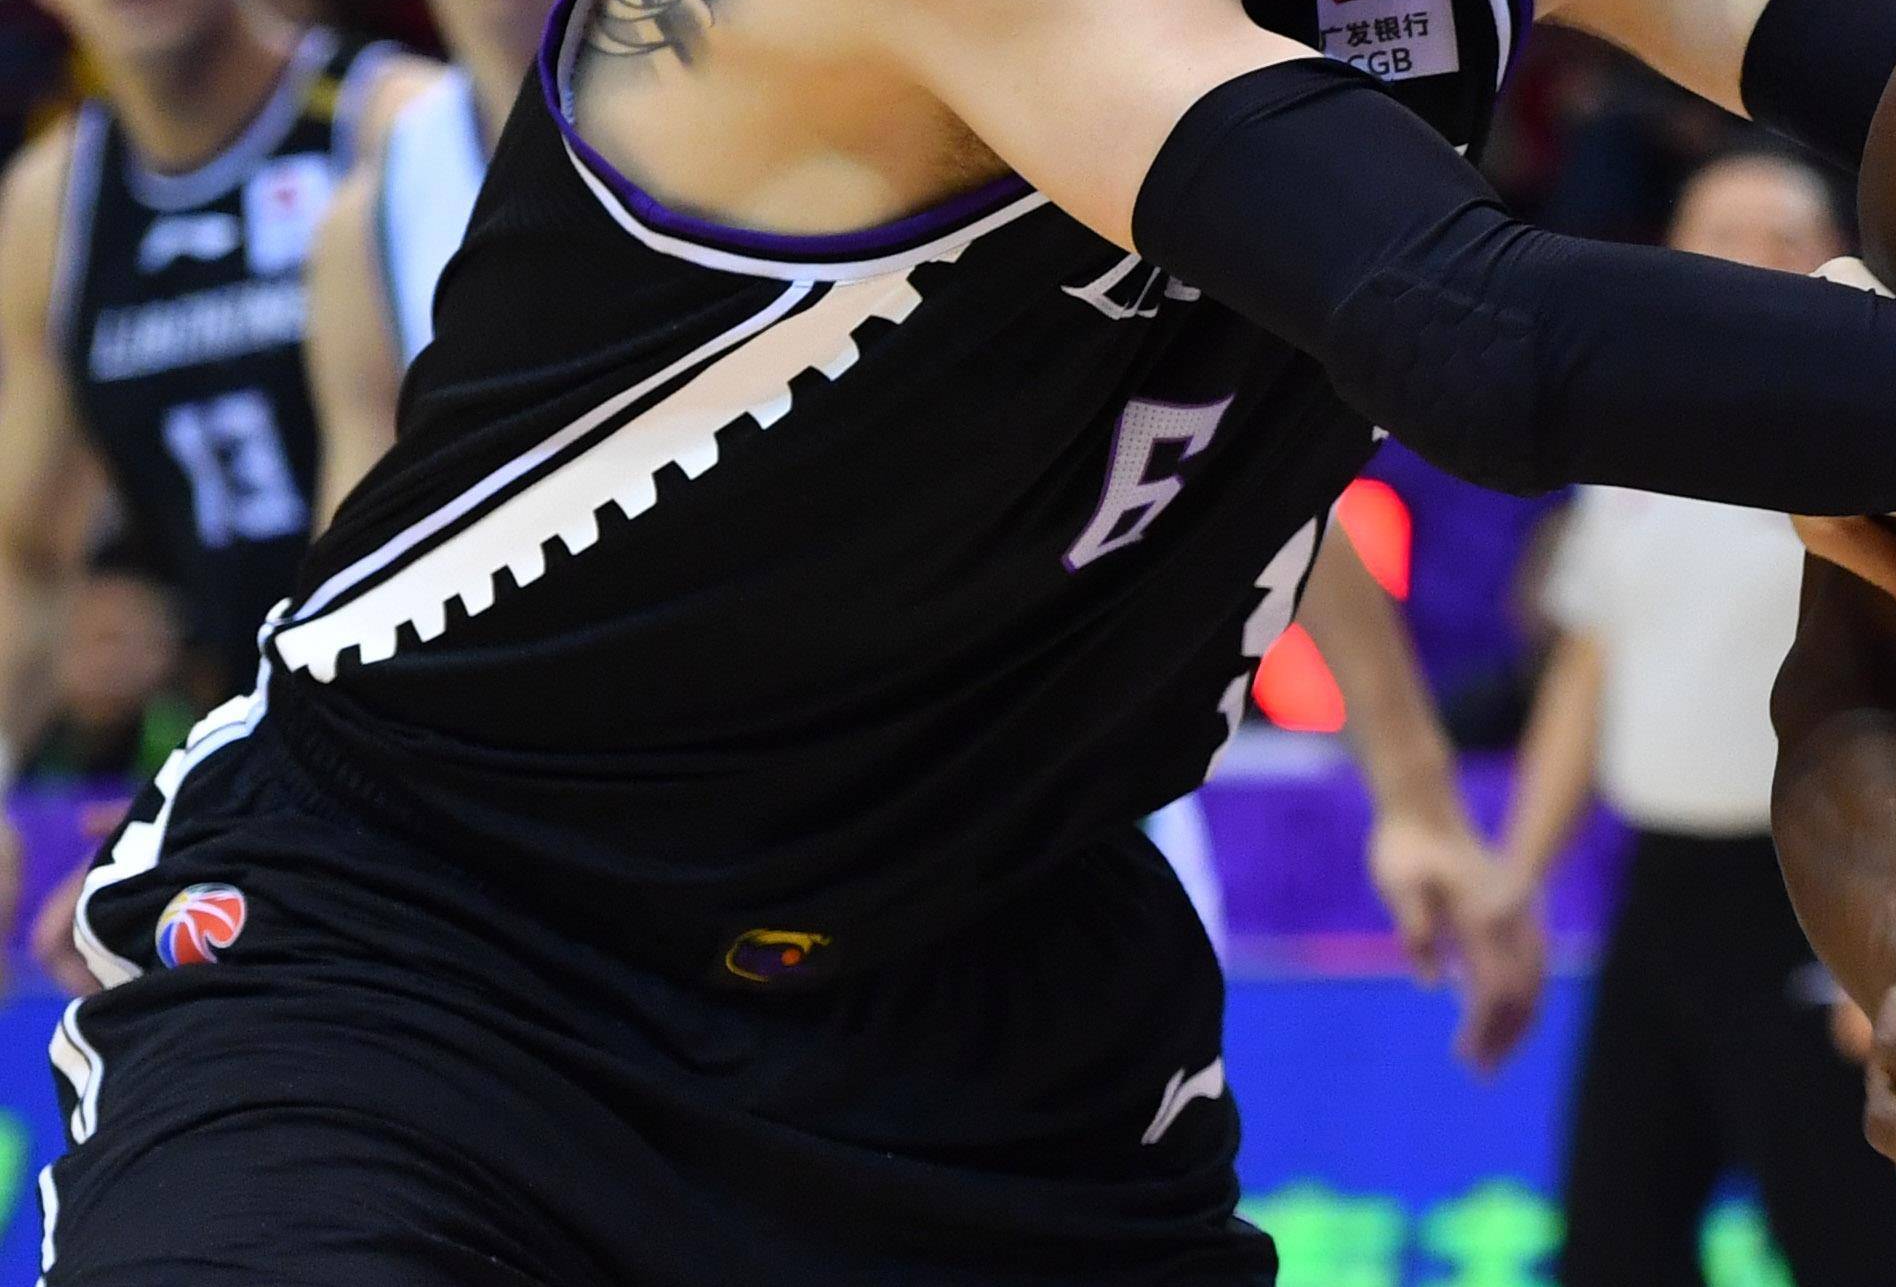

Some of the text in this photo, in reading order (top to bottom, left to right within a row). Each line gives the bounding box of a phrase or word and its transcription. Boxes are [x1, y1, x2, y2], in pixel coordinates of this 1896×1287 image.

[1321, 12, 1428, 52] 广发银行
[160, 387, 312, 550] 13
[1062, 392, 1236, 574] 6
